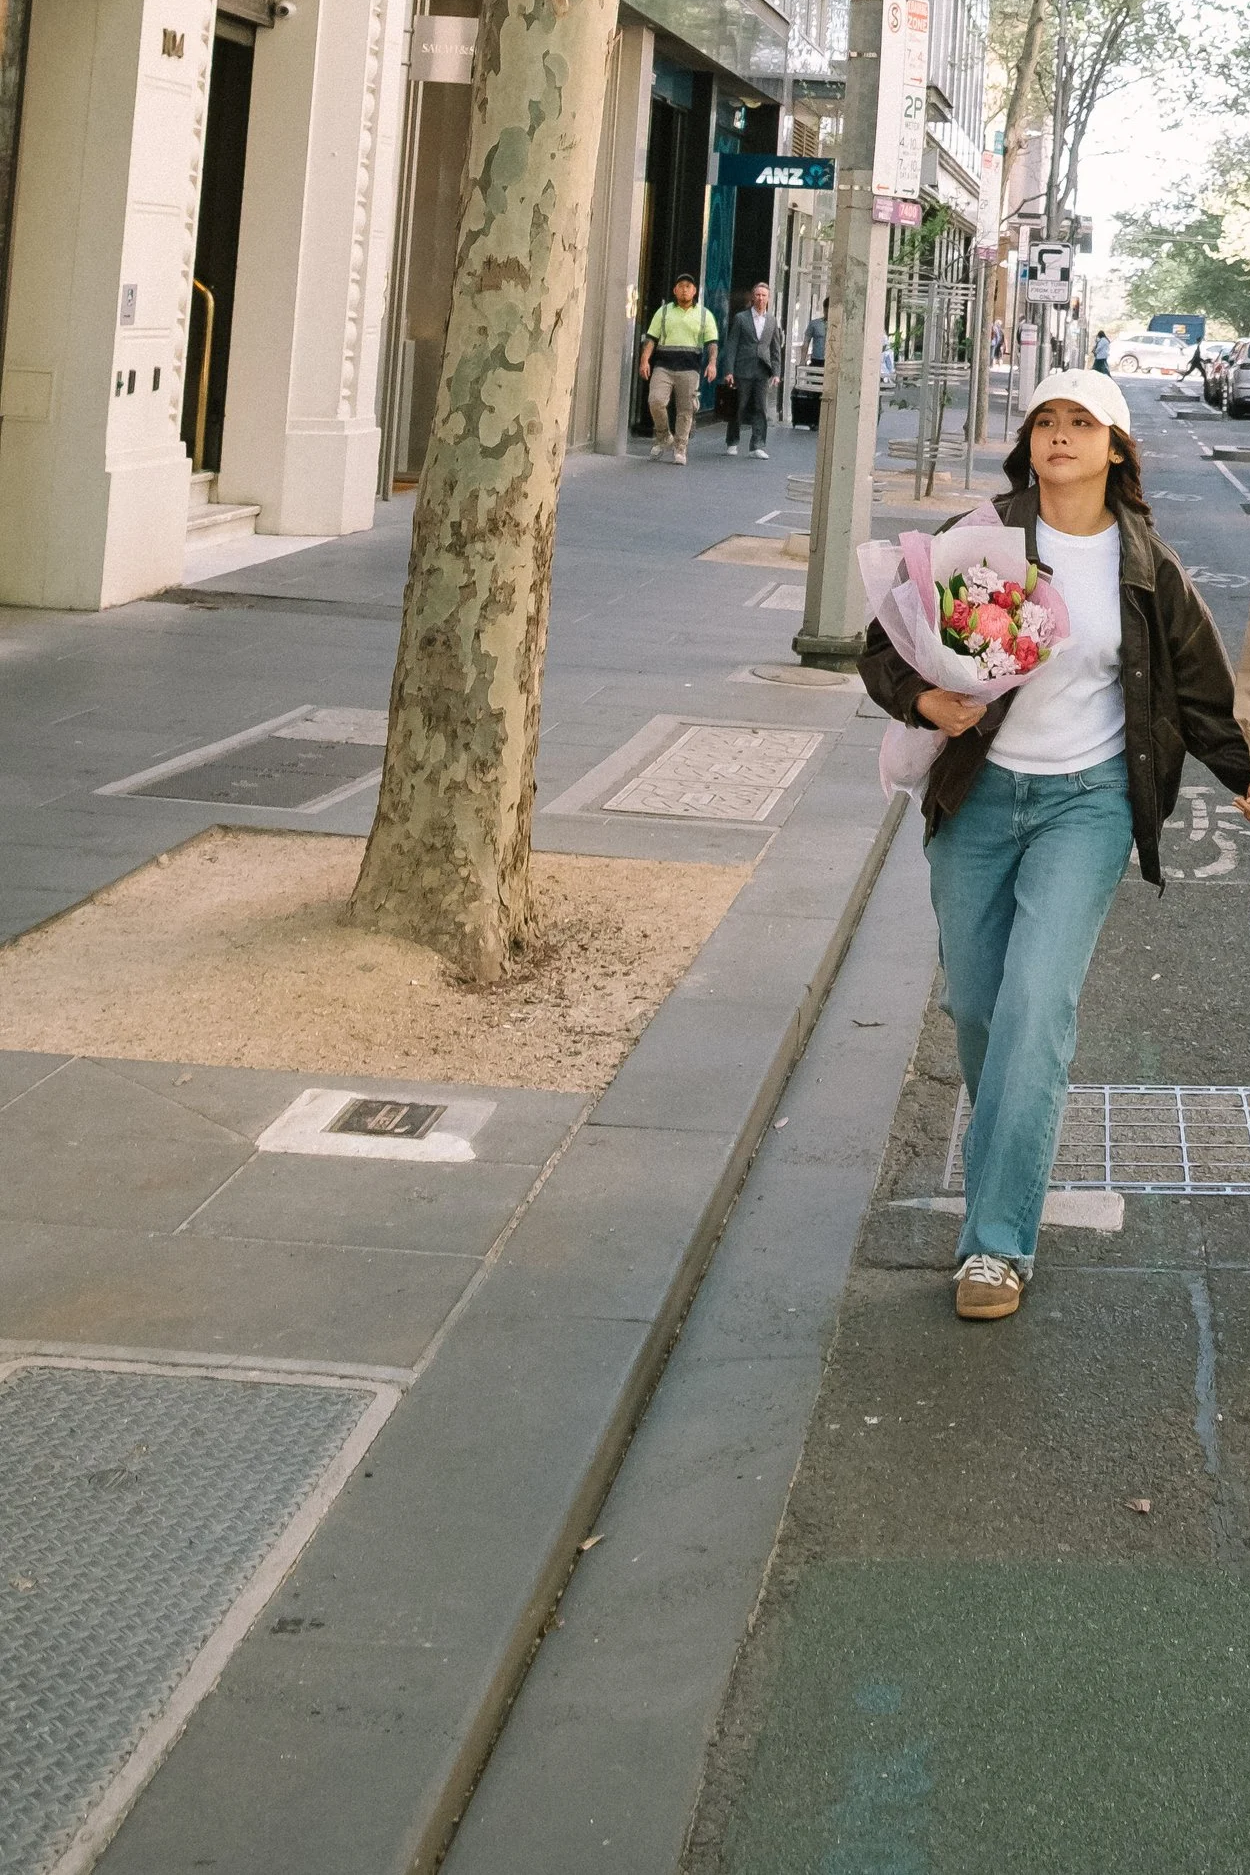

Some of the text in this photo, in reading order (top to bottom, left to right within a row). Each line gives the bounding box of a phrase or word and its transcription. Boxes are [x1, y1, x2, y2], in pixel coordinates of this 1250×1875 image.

[907, 16, 928, 31] ZONE
[904, 94, 923, 119] 2P
[755, 166, 804, 185] ANZ
